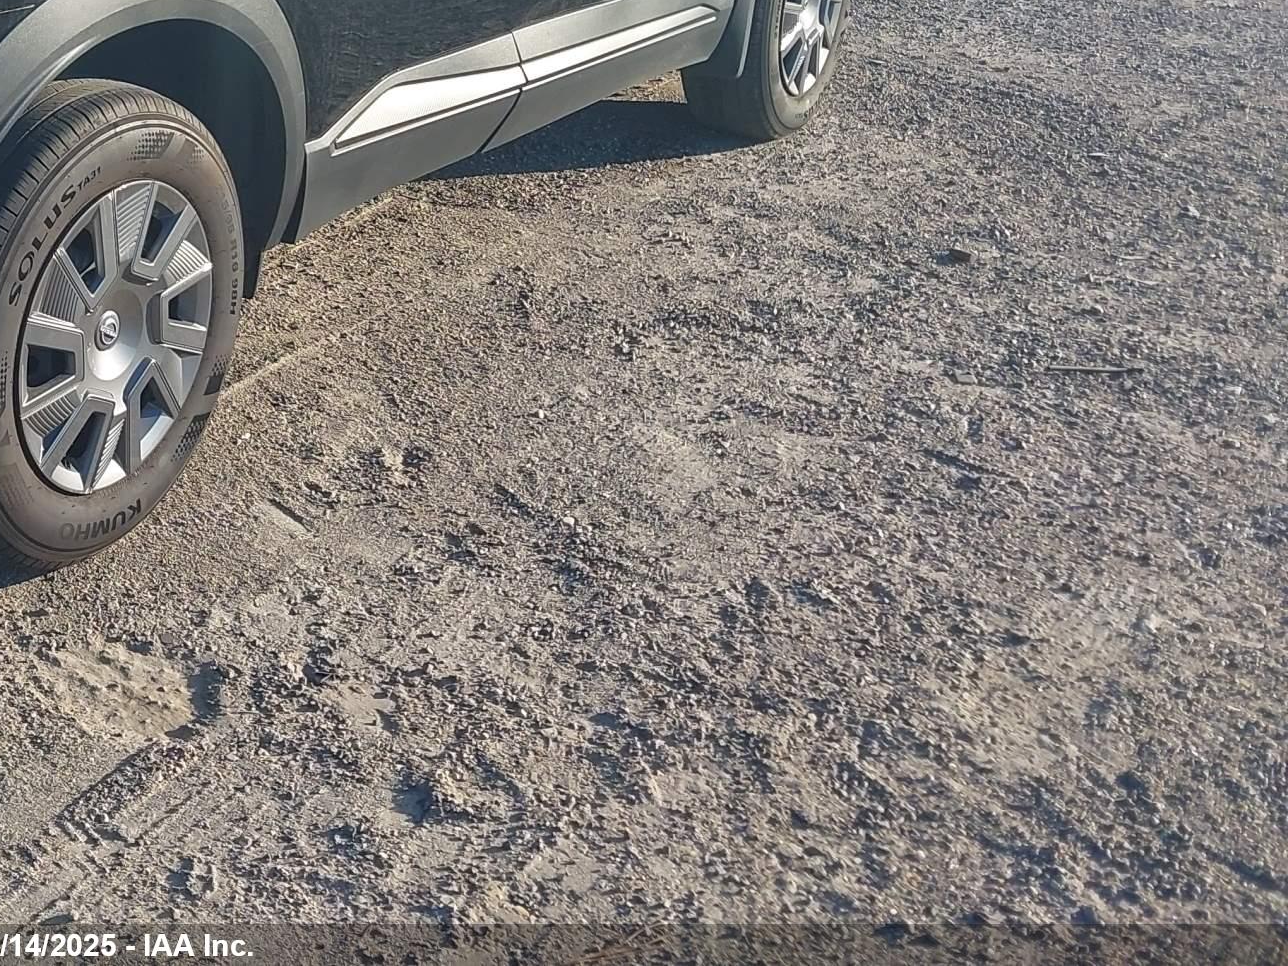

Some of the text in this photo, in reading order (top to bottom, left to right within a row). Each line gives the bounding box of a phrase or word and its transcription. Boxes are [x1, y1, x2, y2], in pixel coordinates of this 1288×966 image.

[8, 166, 102, 307] SOLUS TA31
[59, 498, 142, 541] KUMHO
